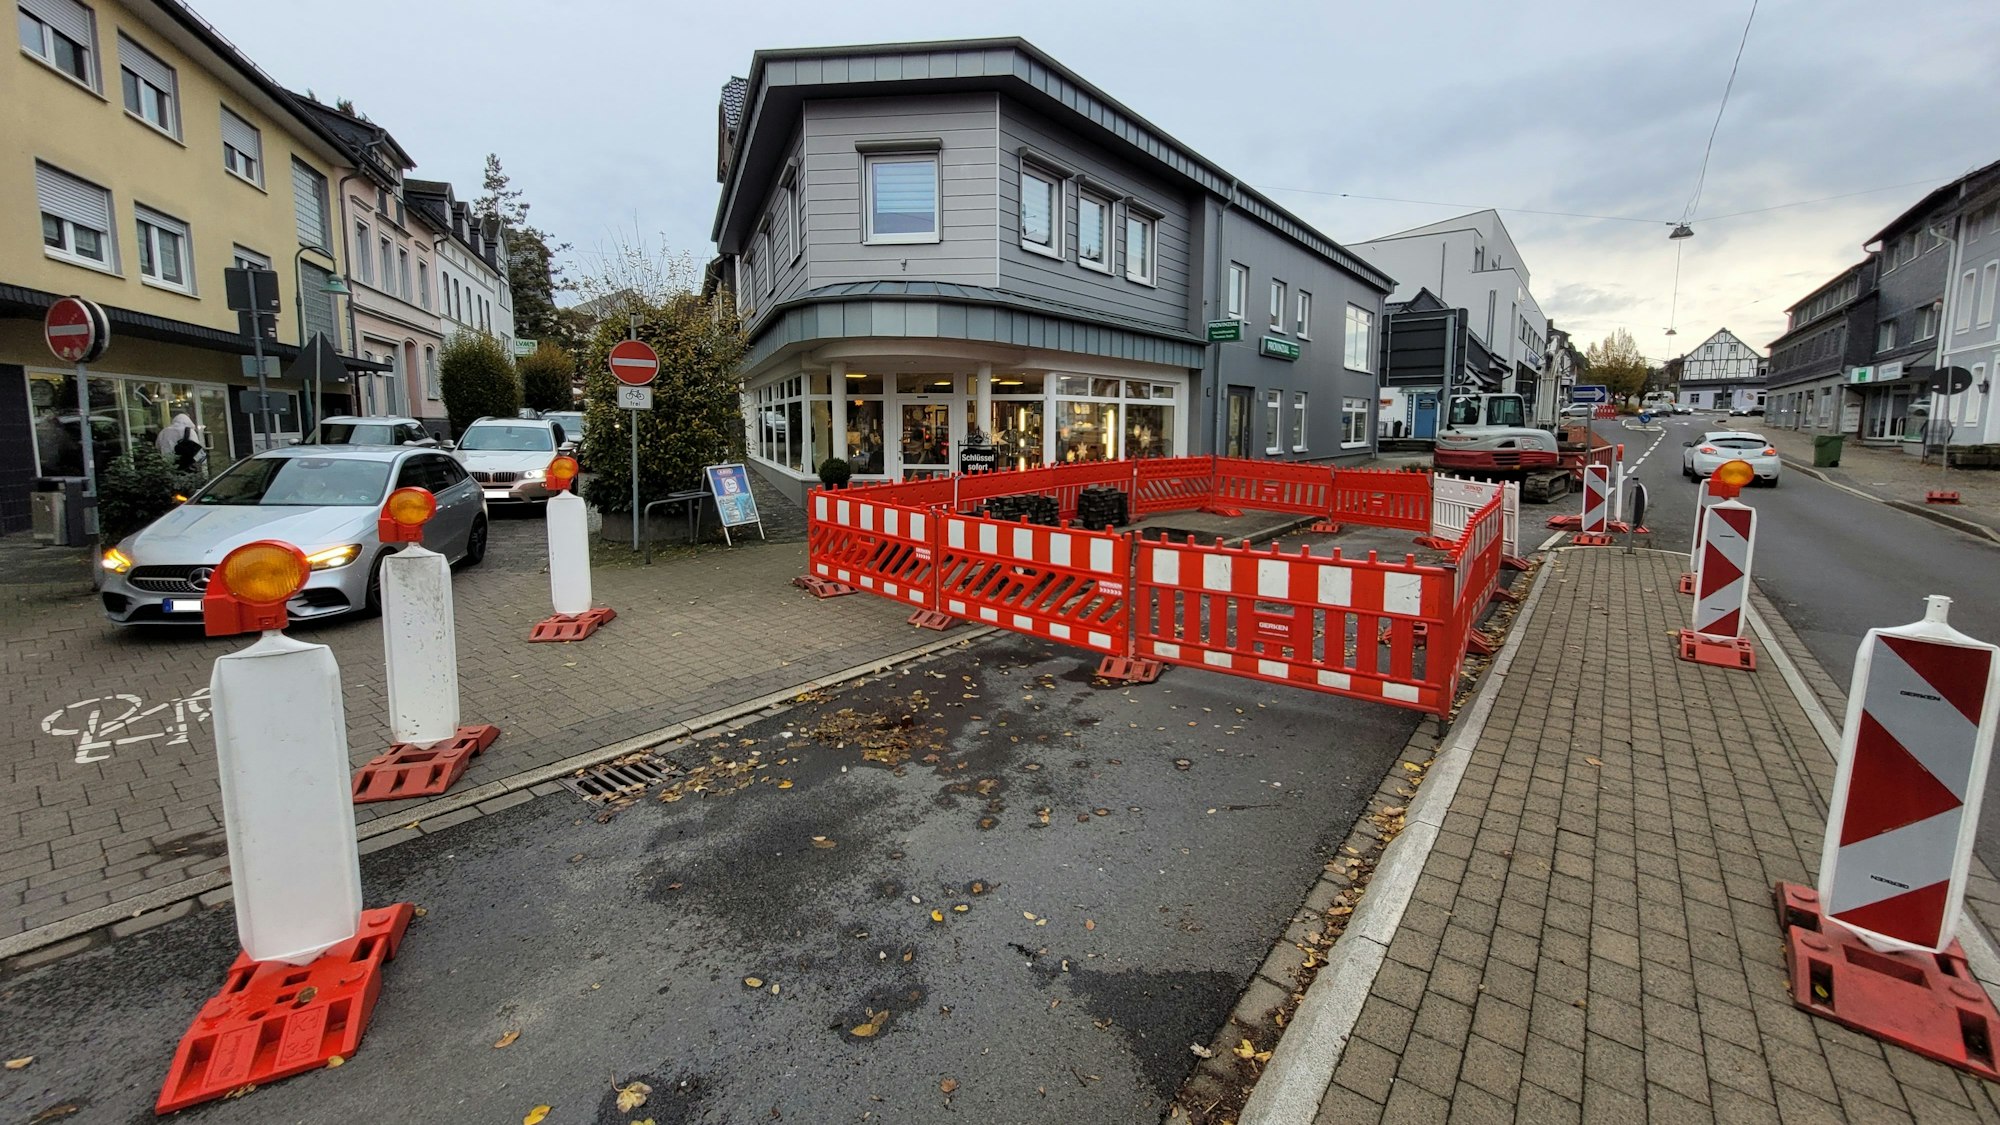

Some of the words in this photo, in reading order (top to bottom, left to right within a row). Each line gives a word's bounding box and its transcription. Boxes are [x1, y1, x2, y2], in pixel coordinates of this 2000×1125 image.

[1267, 340, 1290, 354] PROVINZIAL
[961, 453, 995, 462] Schlüssel
[967, 462, 989, 471] sofort
[1258, 621, 1289, 632] GERKEN
[1900, 690, 1941, 702] GERKEN
